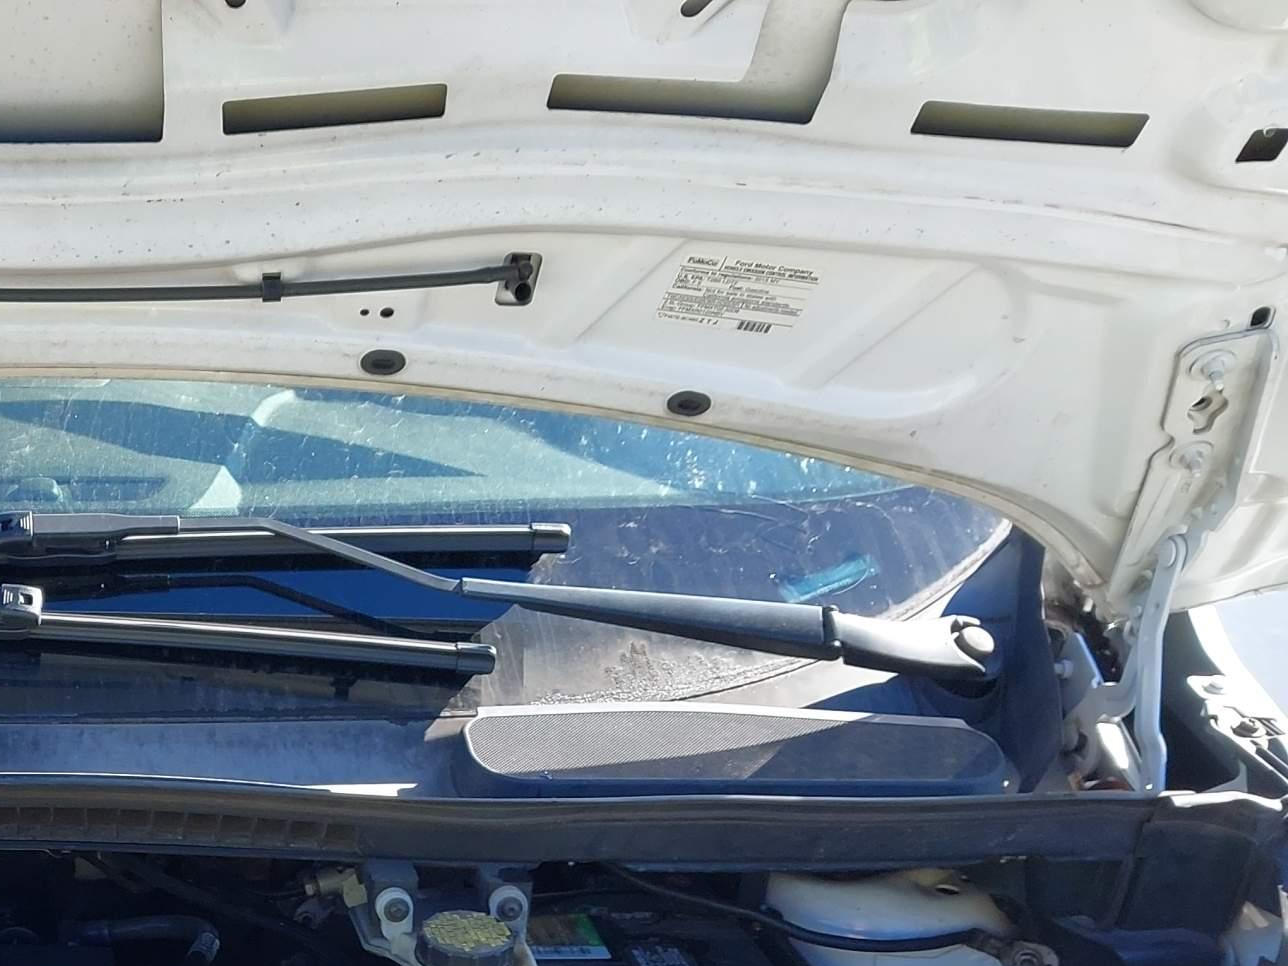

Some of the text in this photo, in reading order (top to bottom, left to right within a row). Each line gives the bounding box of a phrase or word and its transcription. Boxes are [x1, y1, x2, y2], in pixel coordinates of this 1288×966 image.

[735, 259, 814, 276] Ford Motor Company
